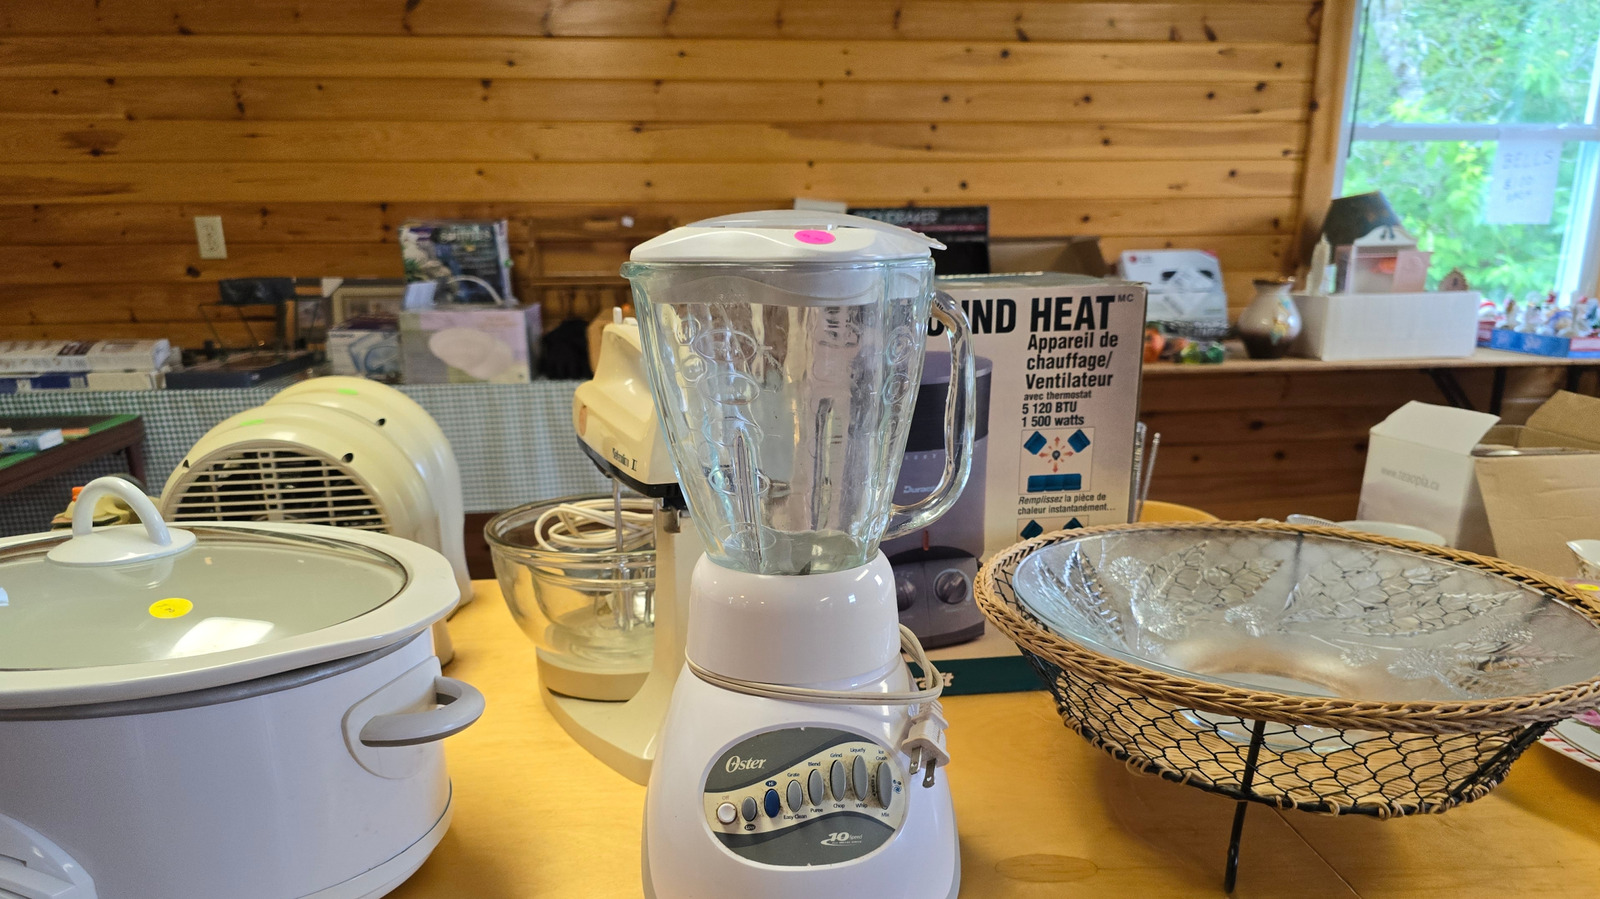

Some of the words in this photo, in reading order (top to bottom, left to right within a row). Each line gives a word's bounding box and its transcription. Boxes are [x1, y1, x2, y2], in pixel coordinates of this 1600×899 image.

[1030, 296, 1115, 332] HEAT
[1118, 294, 1134, 303] MC
[1027, 335, 1094, 353] Appareil
[1100, 334, 1118, 348] de
[1027, 352, 1113, 371] chauffage/
[1026, 373, 1113, 390] Ventilateur
[1024, 393, 1043, 401] avec
[1046, 391, 1092, 400] thermostat
[1022, 403, 1029, 414] 5
[1033, 403, 1052, 414] 120
[1055, 401, 1077, 413] BTU
[1021, 416, 1027, 427] 1
[1031, 416, 1051, 427] 500
[1054, 414, 1084, 425] watts
[1018, 495, 1063, 506] Remplissez
[1064, 494, 1072, 503] la
[1074, 493, 1095, 504] pièce
[1097, 493, 1106, 501] de
[1018, 505, 1047, 515] chaleur
[725, 755, 766, 773] Oster
[828, 832, 850, 841] 10
